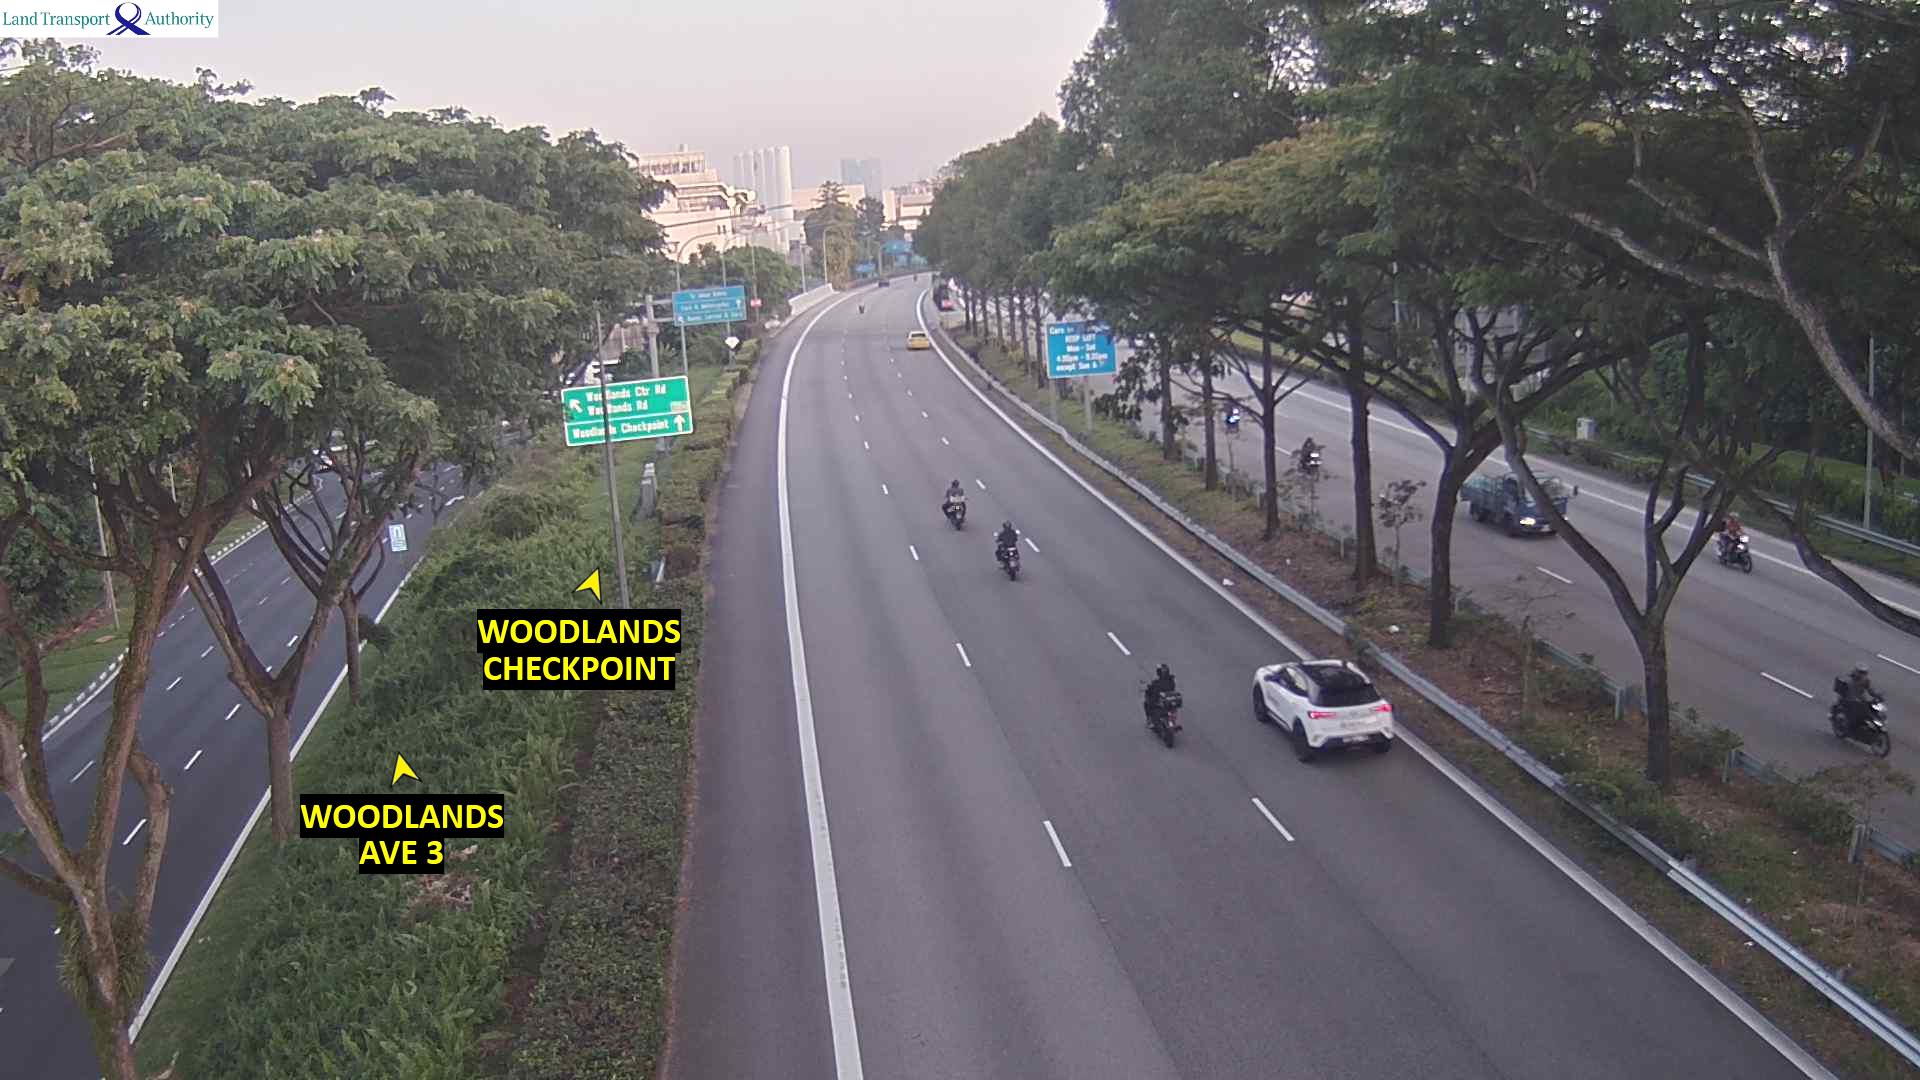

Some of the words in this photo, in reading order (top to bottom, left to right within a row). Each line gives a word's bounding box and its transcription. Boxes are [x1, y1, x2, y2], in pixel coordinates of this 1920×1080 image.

[586, 387, 630, 402] Woolands
[635, 386, 650, 397] Ctr
[655, 384, 667, 395] Rd
[587, 401, 632, 416] Woolands
[636, 400, 648, 411] Rd
[621, 419, 669, 434] Checkpoint
